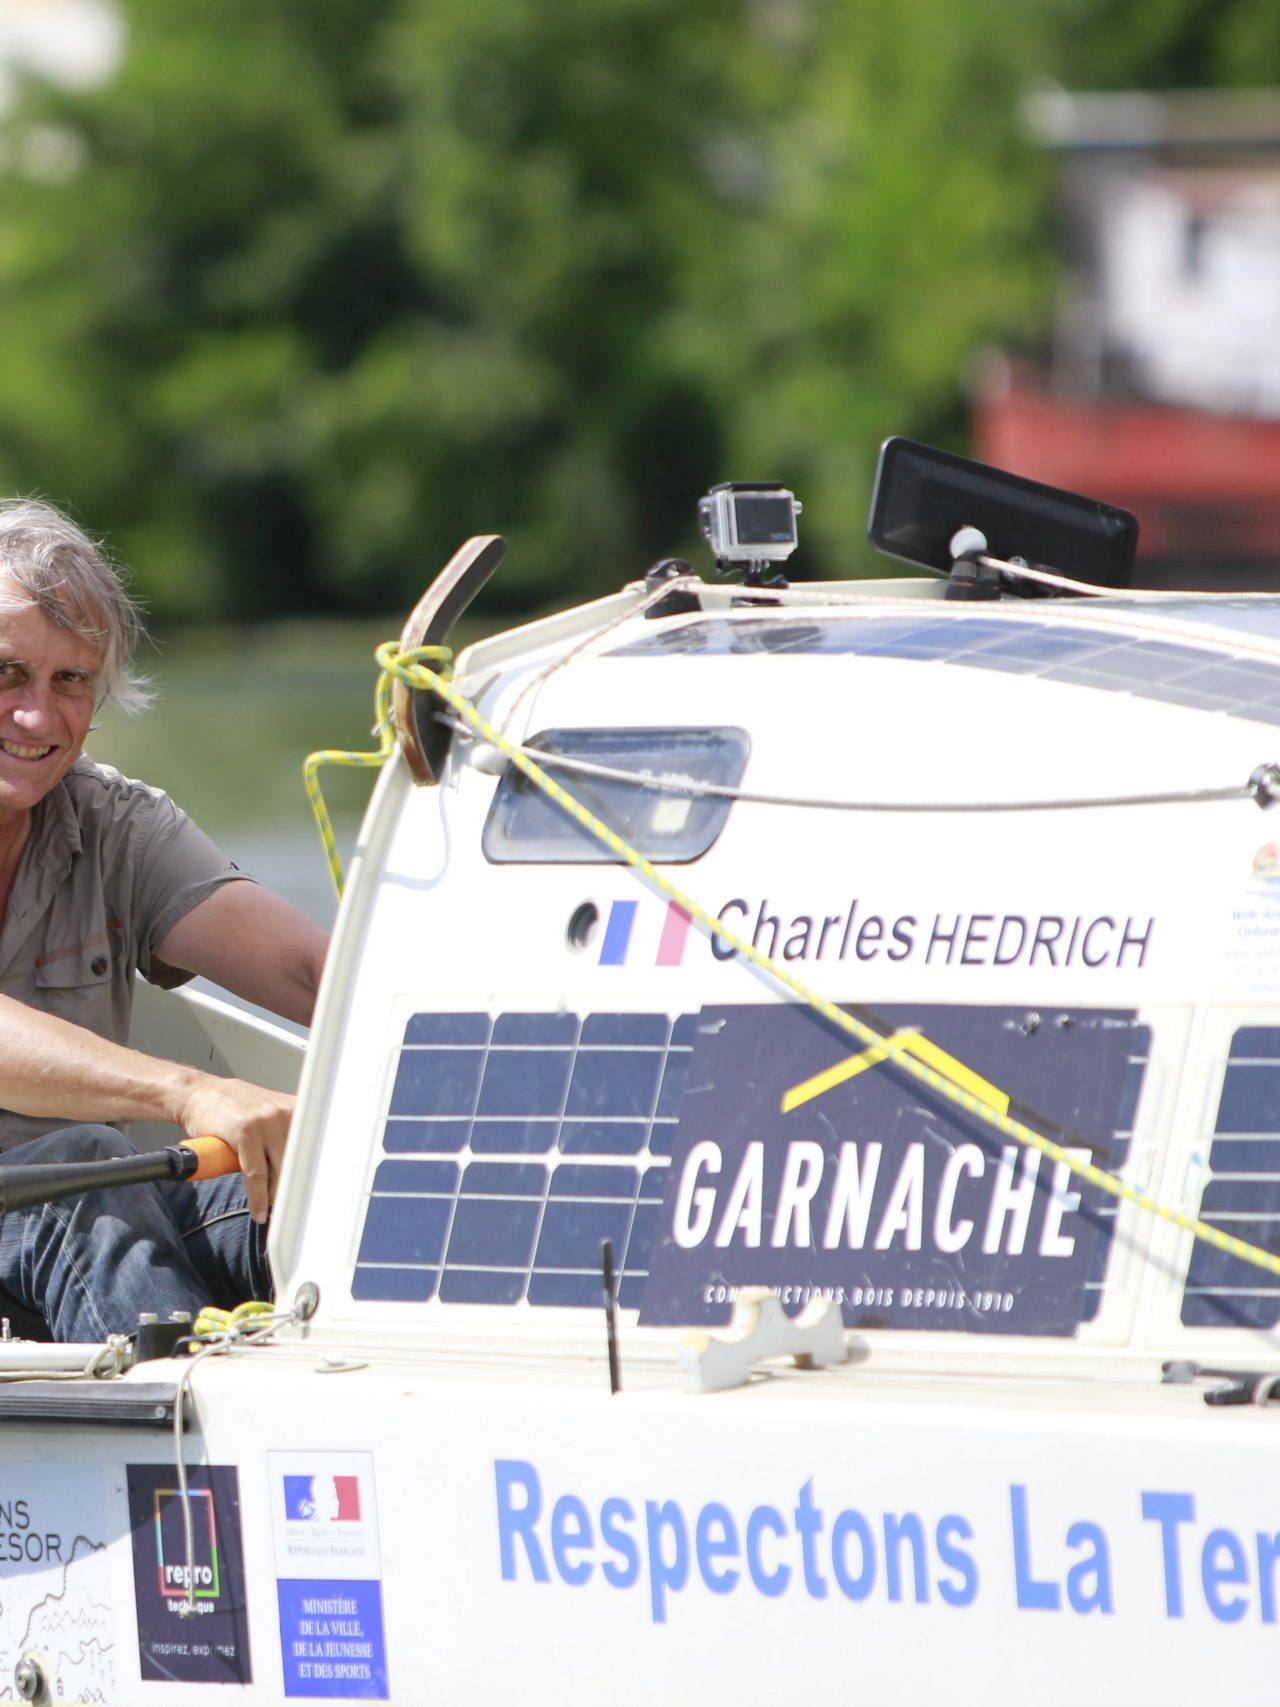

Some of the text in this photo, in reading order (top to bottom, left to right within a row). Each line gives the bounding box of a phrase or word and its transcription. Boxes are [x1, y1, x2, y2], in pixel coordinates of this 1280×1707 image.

[710, 898, 1154, 969] Charles HEDRICH
[673, 1140, 1093, 1258] GARNACHE
[704, 1285, 1015, 1312] CONUCTIONS BOIS DEPUIS 1910
[494, 1458, 1280, 1624] Respectons La Ter
[166, 1565, 213, 1588] repro
[301, 1621, 314, 1636] DE
[316, 1621, 330, 1636] LA
[294, 1642, 373, 1658] DE LA JEUNESSE
[300, 1664, 371, 1680] ET DES SPORTS
